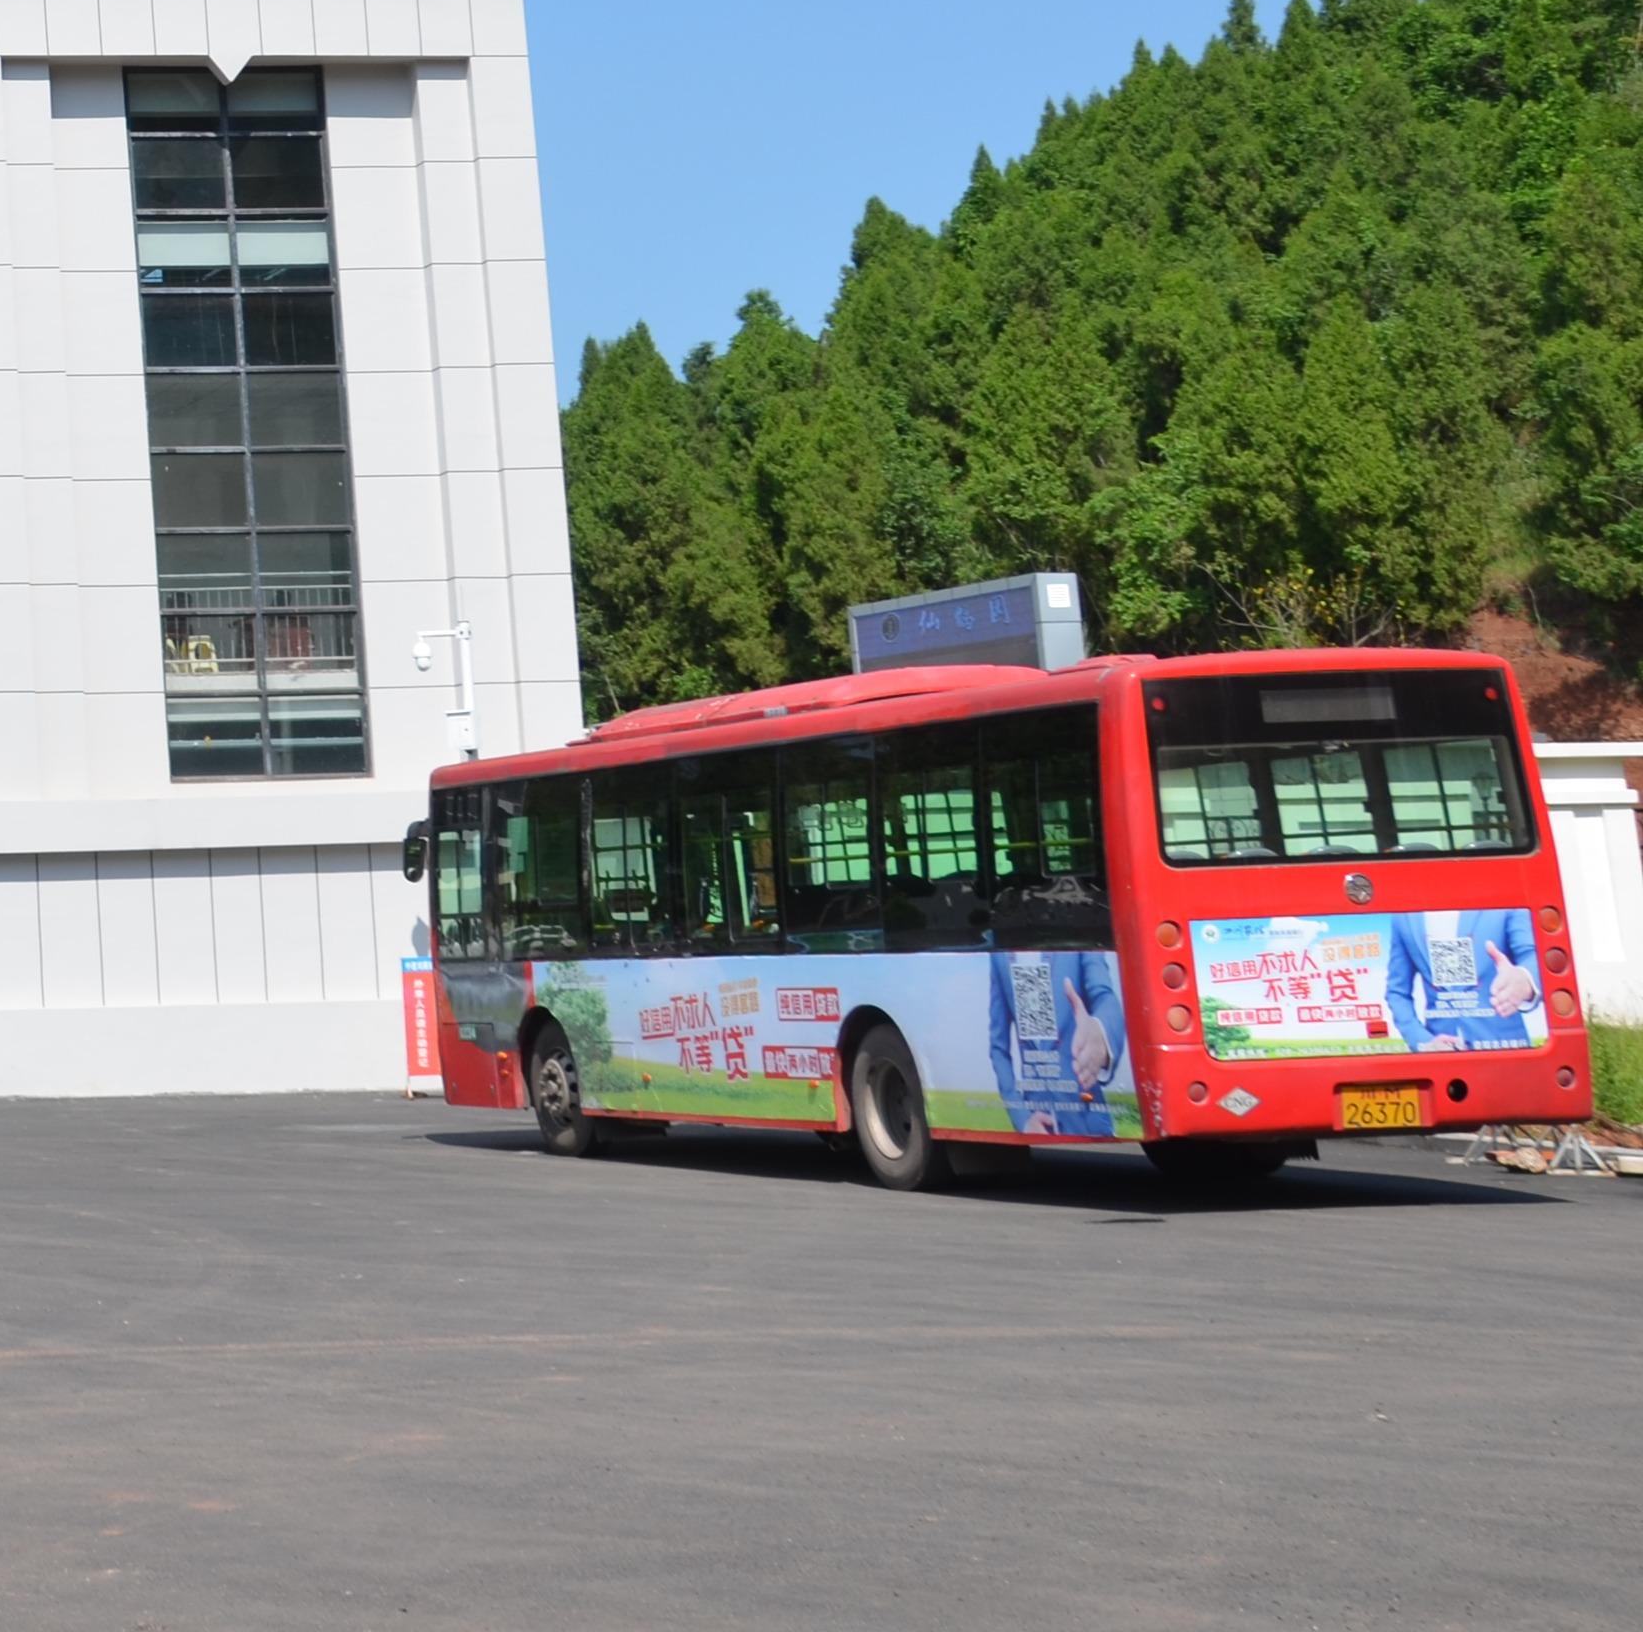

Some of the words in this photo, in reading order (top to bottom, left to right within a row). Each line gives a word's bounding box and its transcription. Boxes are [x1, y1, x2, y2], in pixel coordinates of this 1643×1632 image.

[917, 593, 1012, 633] 仙鹤园
[1209, 949, 1319, 980] 好信用不求人
[639, 991, 717, 1034] 好信用不求人
[1346, 1101, 1417, 1125] 26370
